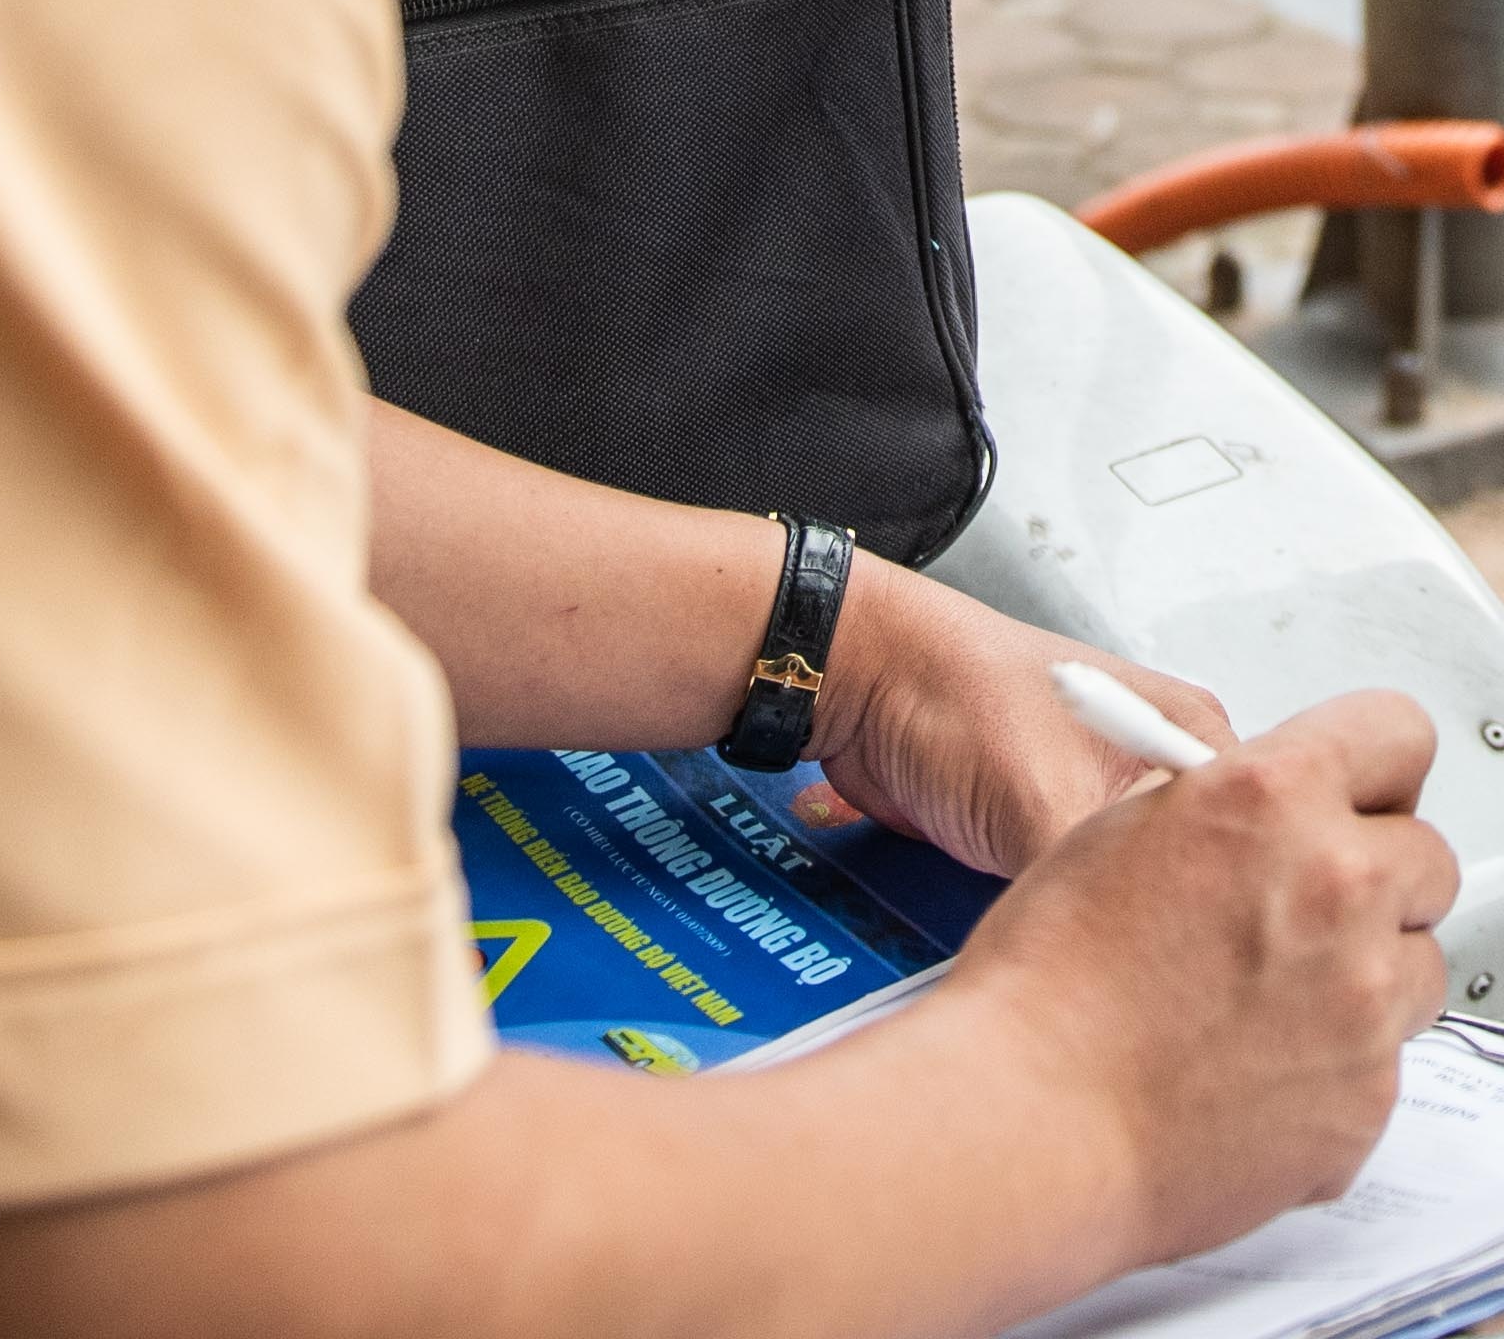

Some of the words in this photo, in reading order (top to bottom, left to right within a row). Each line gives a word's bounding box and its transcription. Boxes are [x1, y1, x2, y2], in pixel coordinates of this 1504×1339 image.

[550, 749, 631, 794] IAO
[604, 785, 713, 879] THÔNG
[686, 867, 807, 955] ĐƯỜNG
[778, 941, 853, 986] BỘ
[709, 792, 813, 871] LUẬT
[690, 988, 744, 1027] NAM
